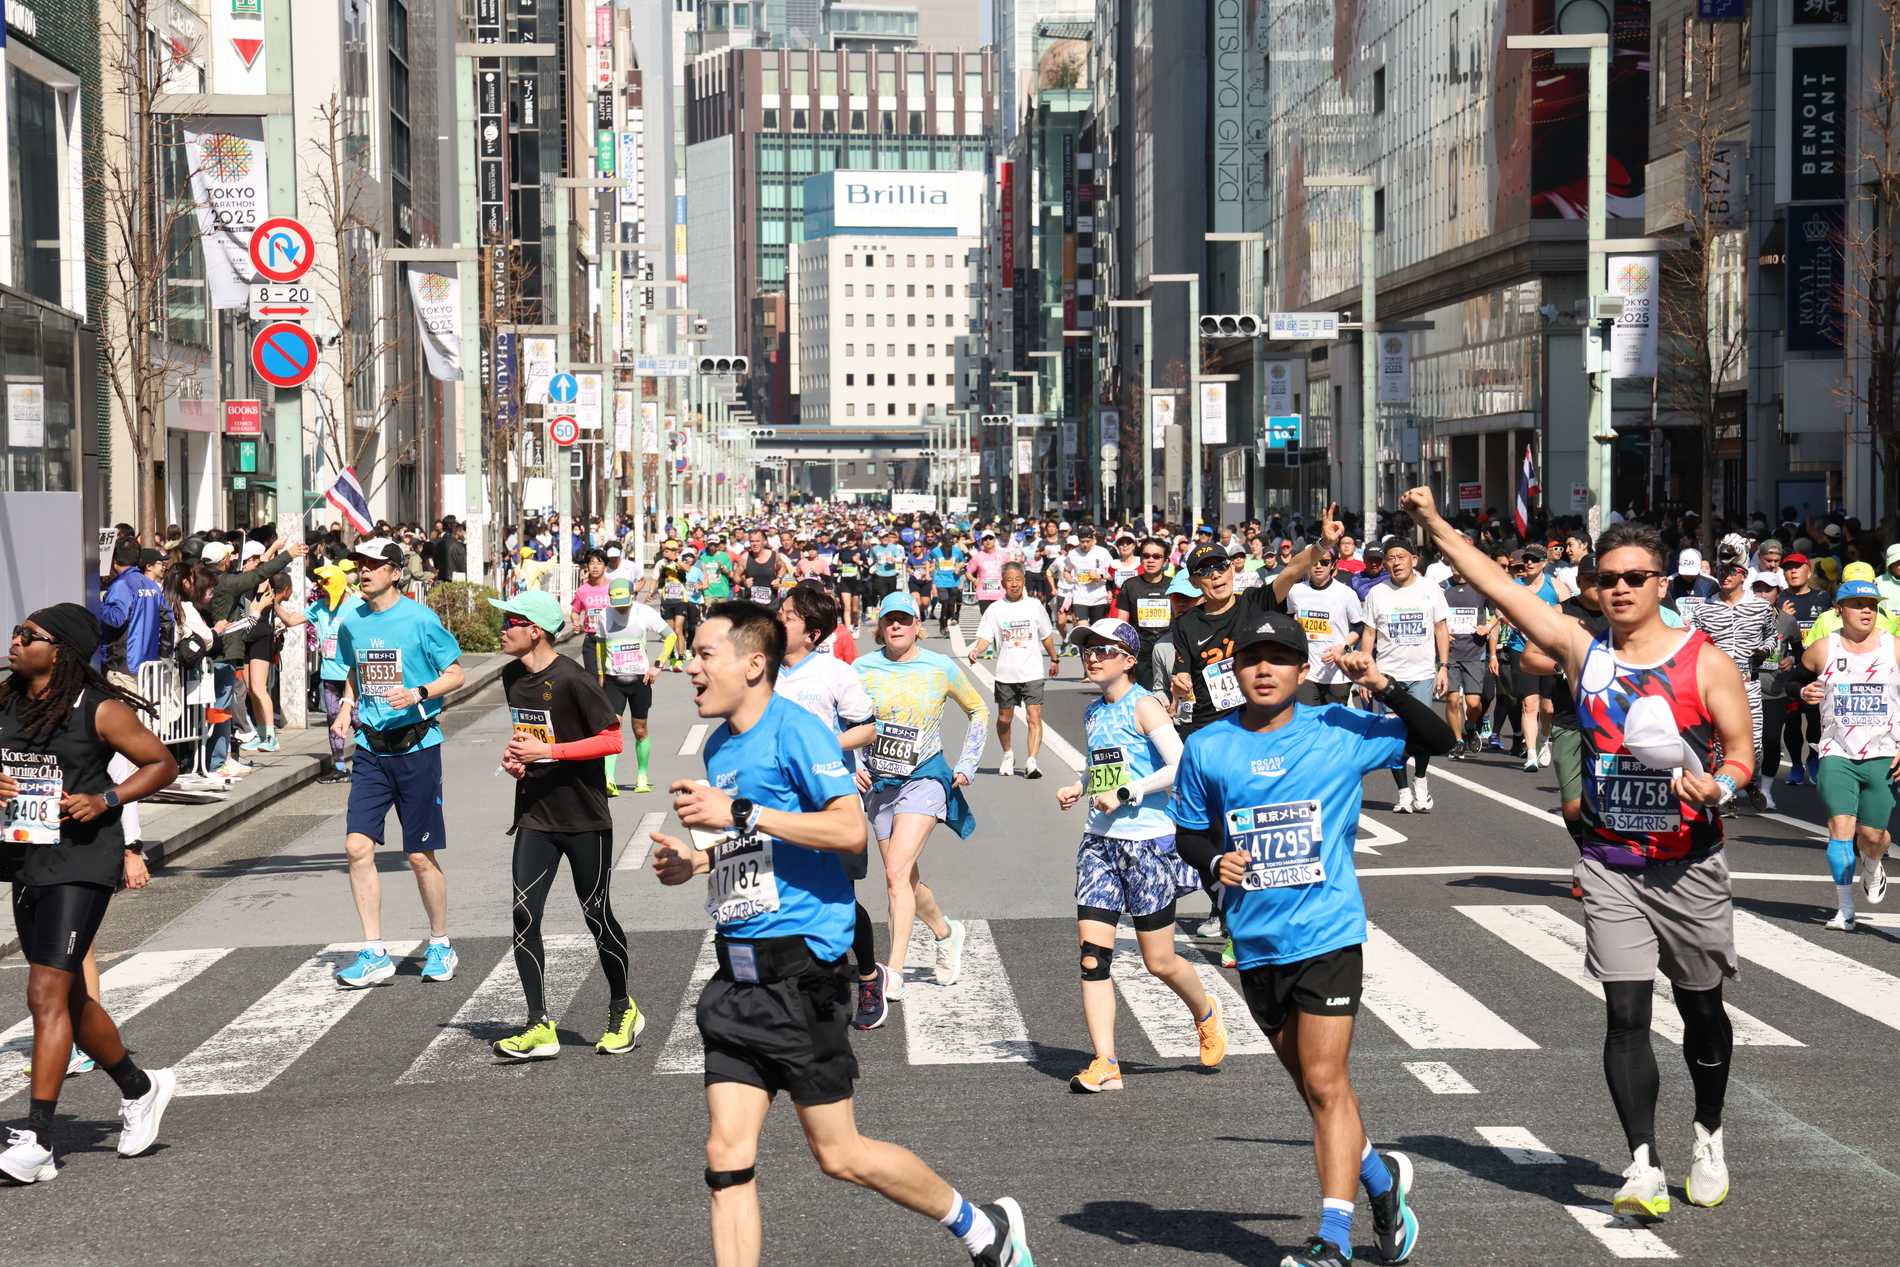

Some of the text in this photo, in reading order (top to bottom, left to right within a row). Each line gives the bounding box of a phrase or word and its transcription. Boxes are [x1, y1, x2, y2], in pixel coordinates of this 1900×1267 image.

[1802, 74, 1816, 174] BENOIT
[1820, 74, 1835, 174] NIHANT
[207, 187, 255, 199] TOKYO
[847, 184, 949, 205] Brillia
[211, 210, 256, 225] 2025
[495, 262, 505, 308] PILATES
[1799, 265, 1814, 324] ROYAL
[421, 305, 453, 315] TOKYO
[1617, 313, 1650, 323] 2025
[1275, 319, 1333, 330] 銀座三丁目
[228, 406, 258, 415] BOOKS
[556, 424, 572, 438] 50
[1846, 696, 1881, 712] 47823
[884, 727, 916, 738] 東京メトロ
[1, 748, 57, 765] Koreatown
[876, 737, 912, 759] 16668
[38, 765, 63, 779] Club
[1597, 780, 1668, 807] K 44758
[5, 799, 48, 821] 42408
[1256, 808, 1310, 823] 東京メトロ
[1617, 815, 1668, 831] STARTS
[721, 836, 759, 856] 東京メトロ
[1251, 829, 1312, 861] 47295
[716, 860, 761, 897] 17182
[1262, 866, 1312, 887] STARTS
